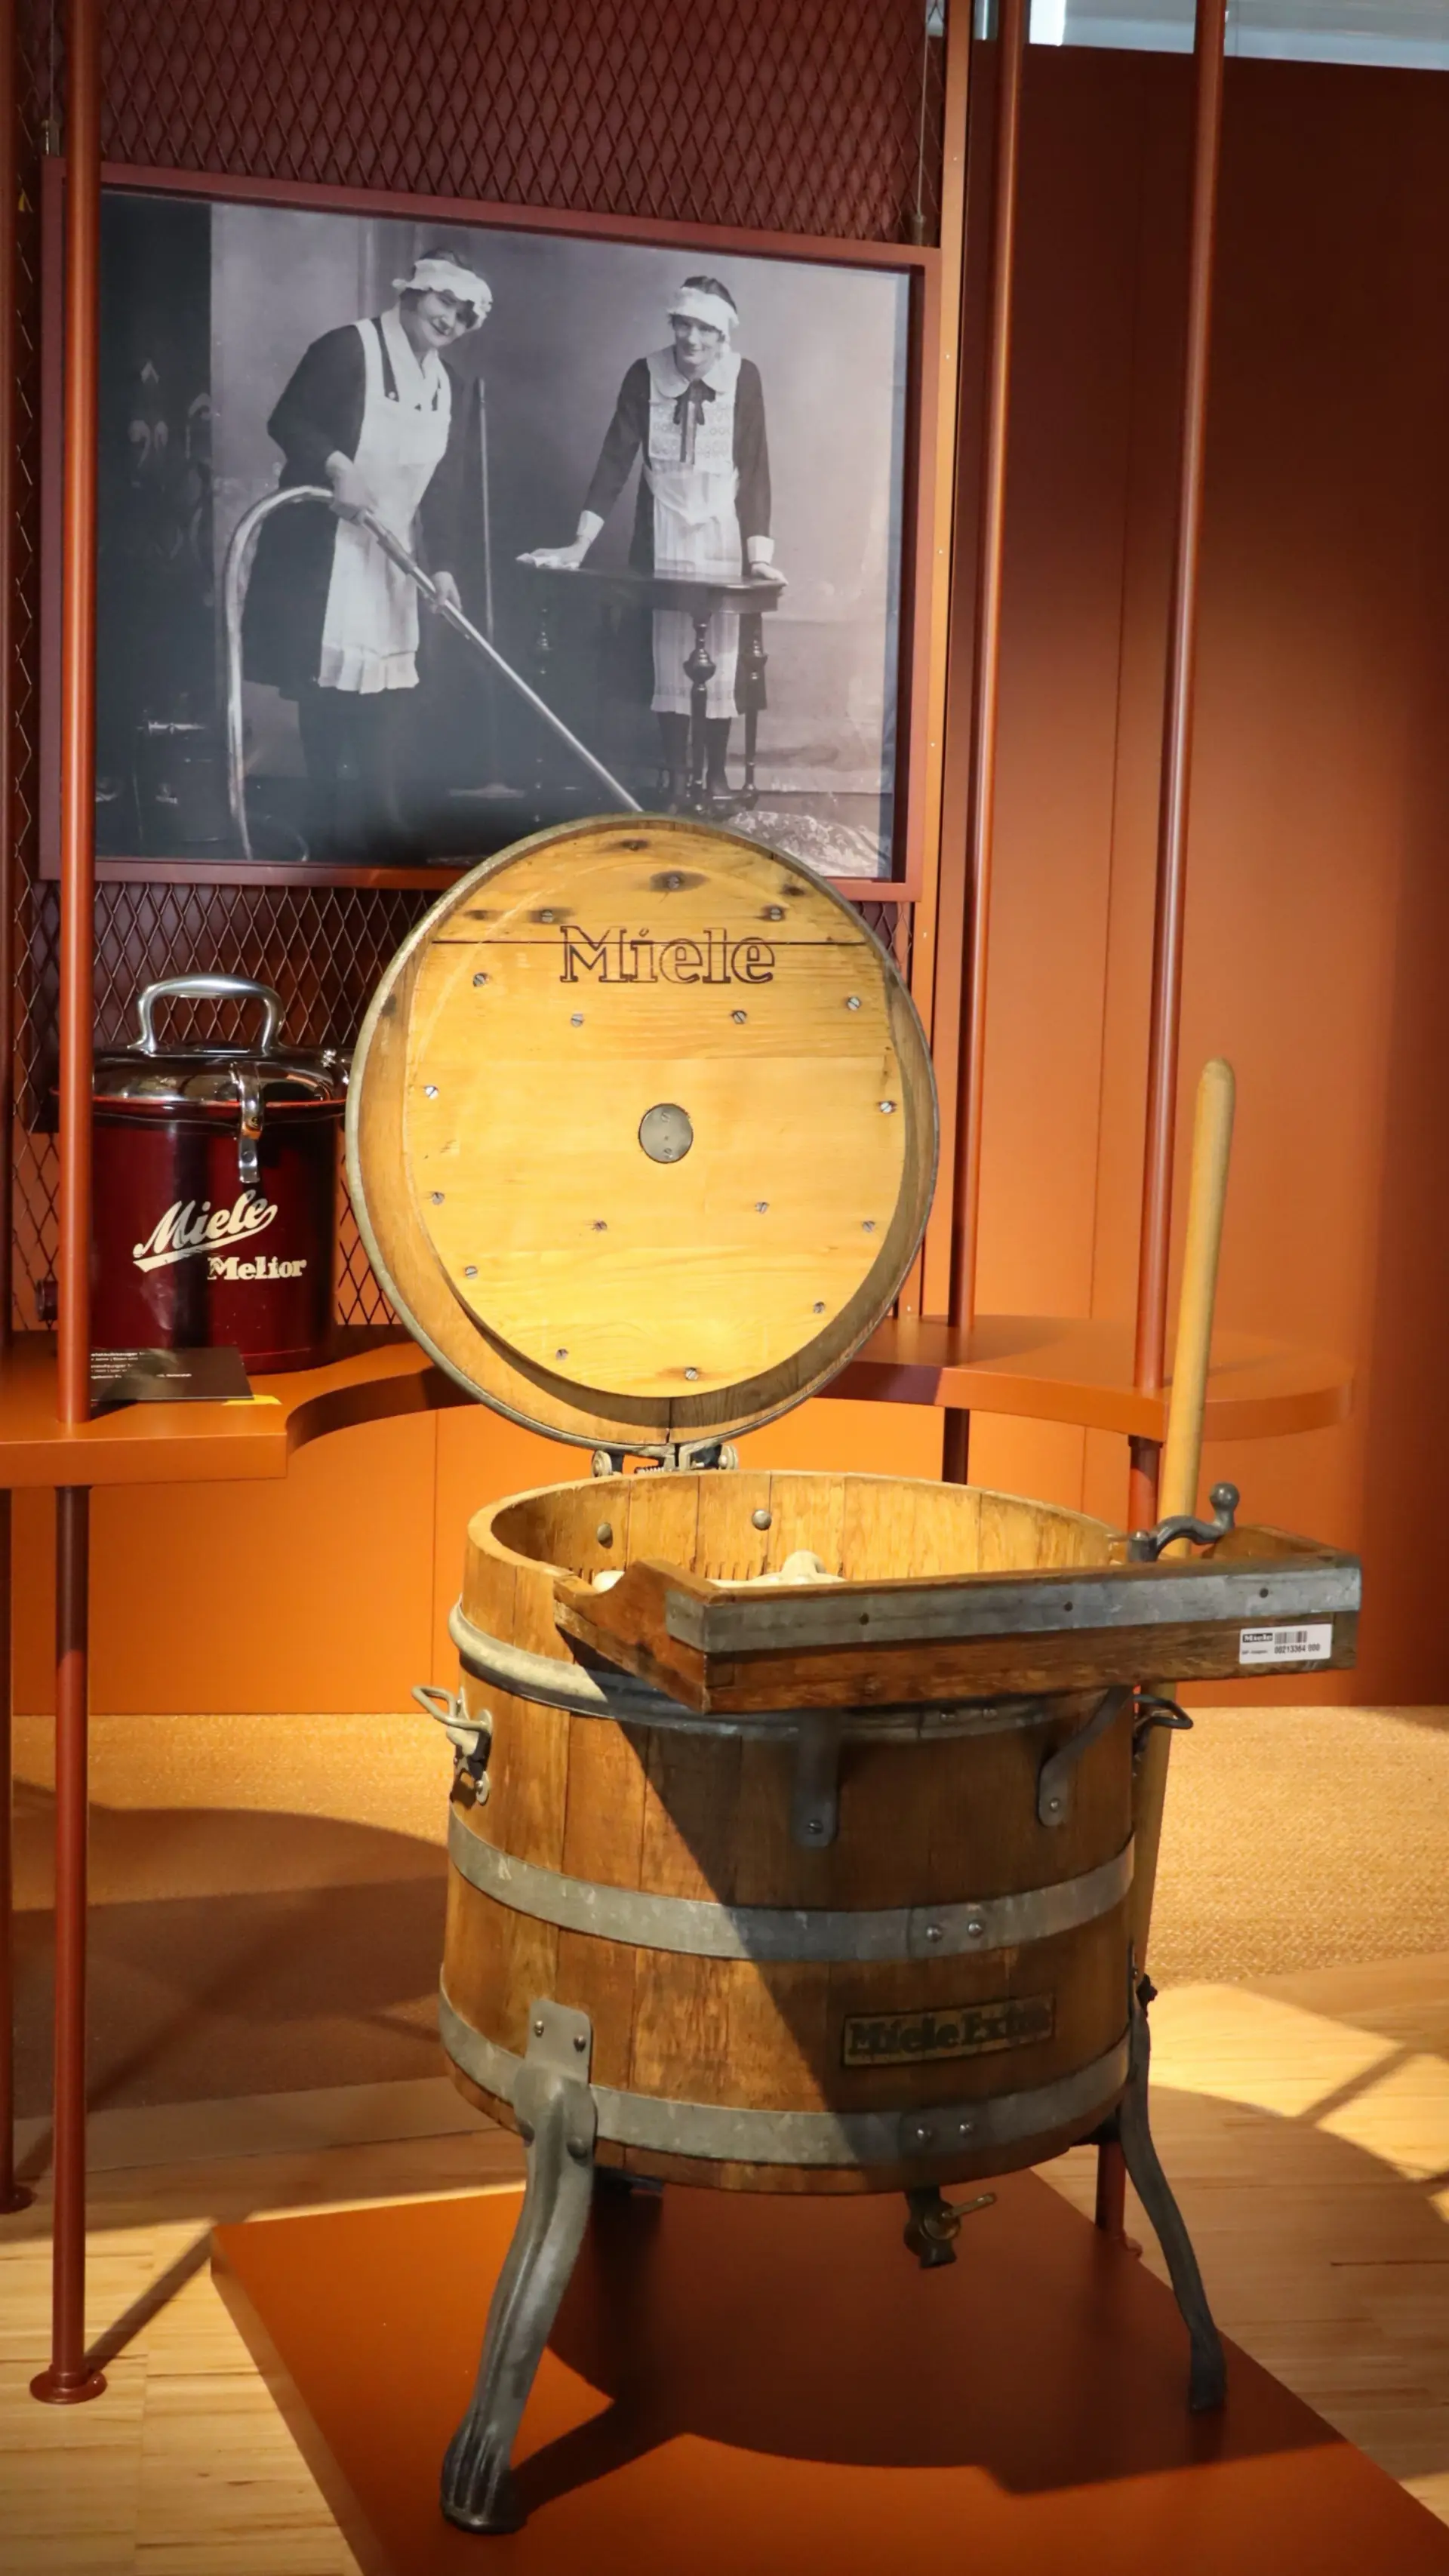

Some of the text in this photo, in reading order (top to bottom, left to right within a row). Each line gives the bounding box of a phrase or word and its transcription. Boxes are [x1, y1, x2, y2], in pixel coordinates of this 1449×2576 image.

[559, 925, 775, 984] Miele
[132, 1189, 278, 1273] Miele
[207, 1256, 307, 1281] Melior
[1244, 1633, 1272, 1642] Miele
[849, 2016, 960, 2055] Miele
